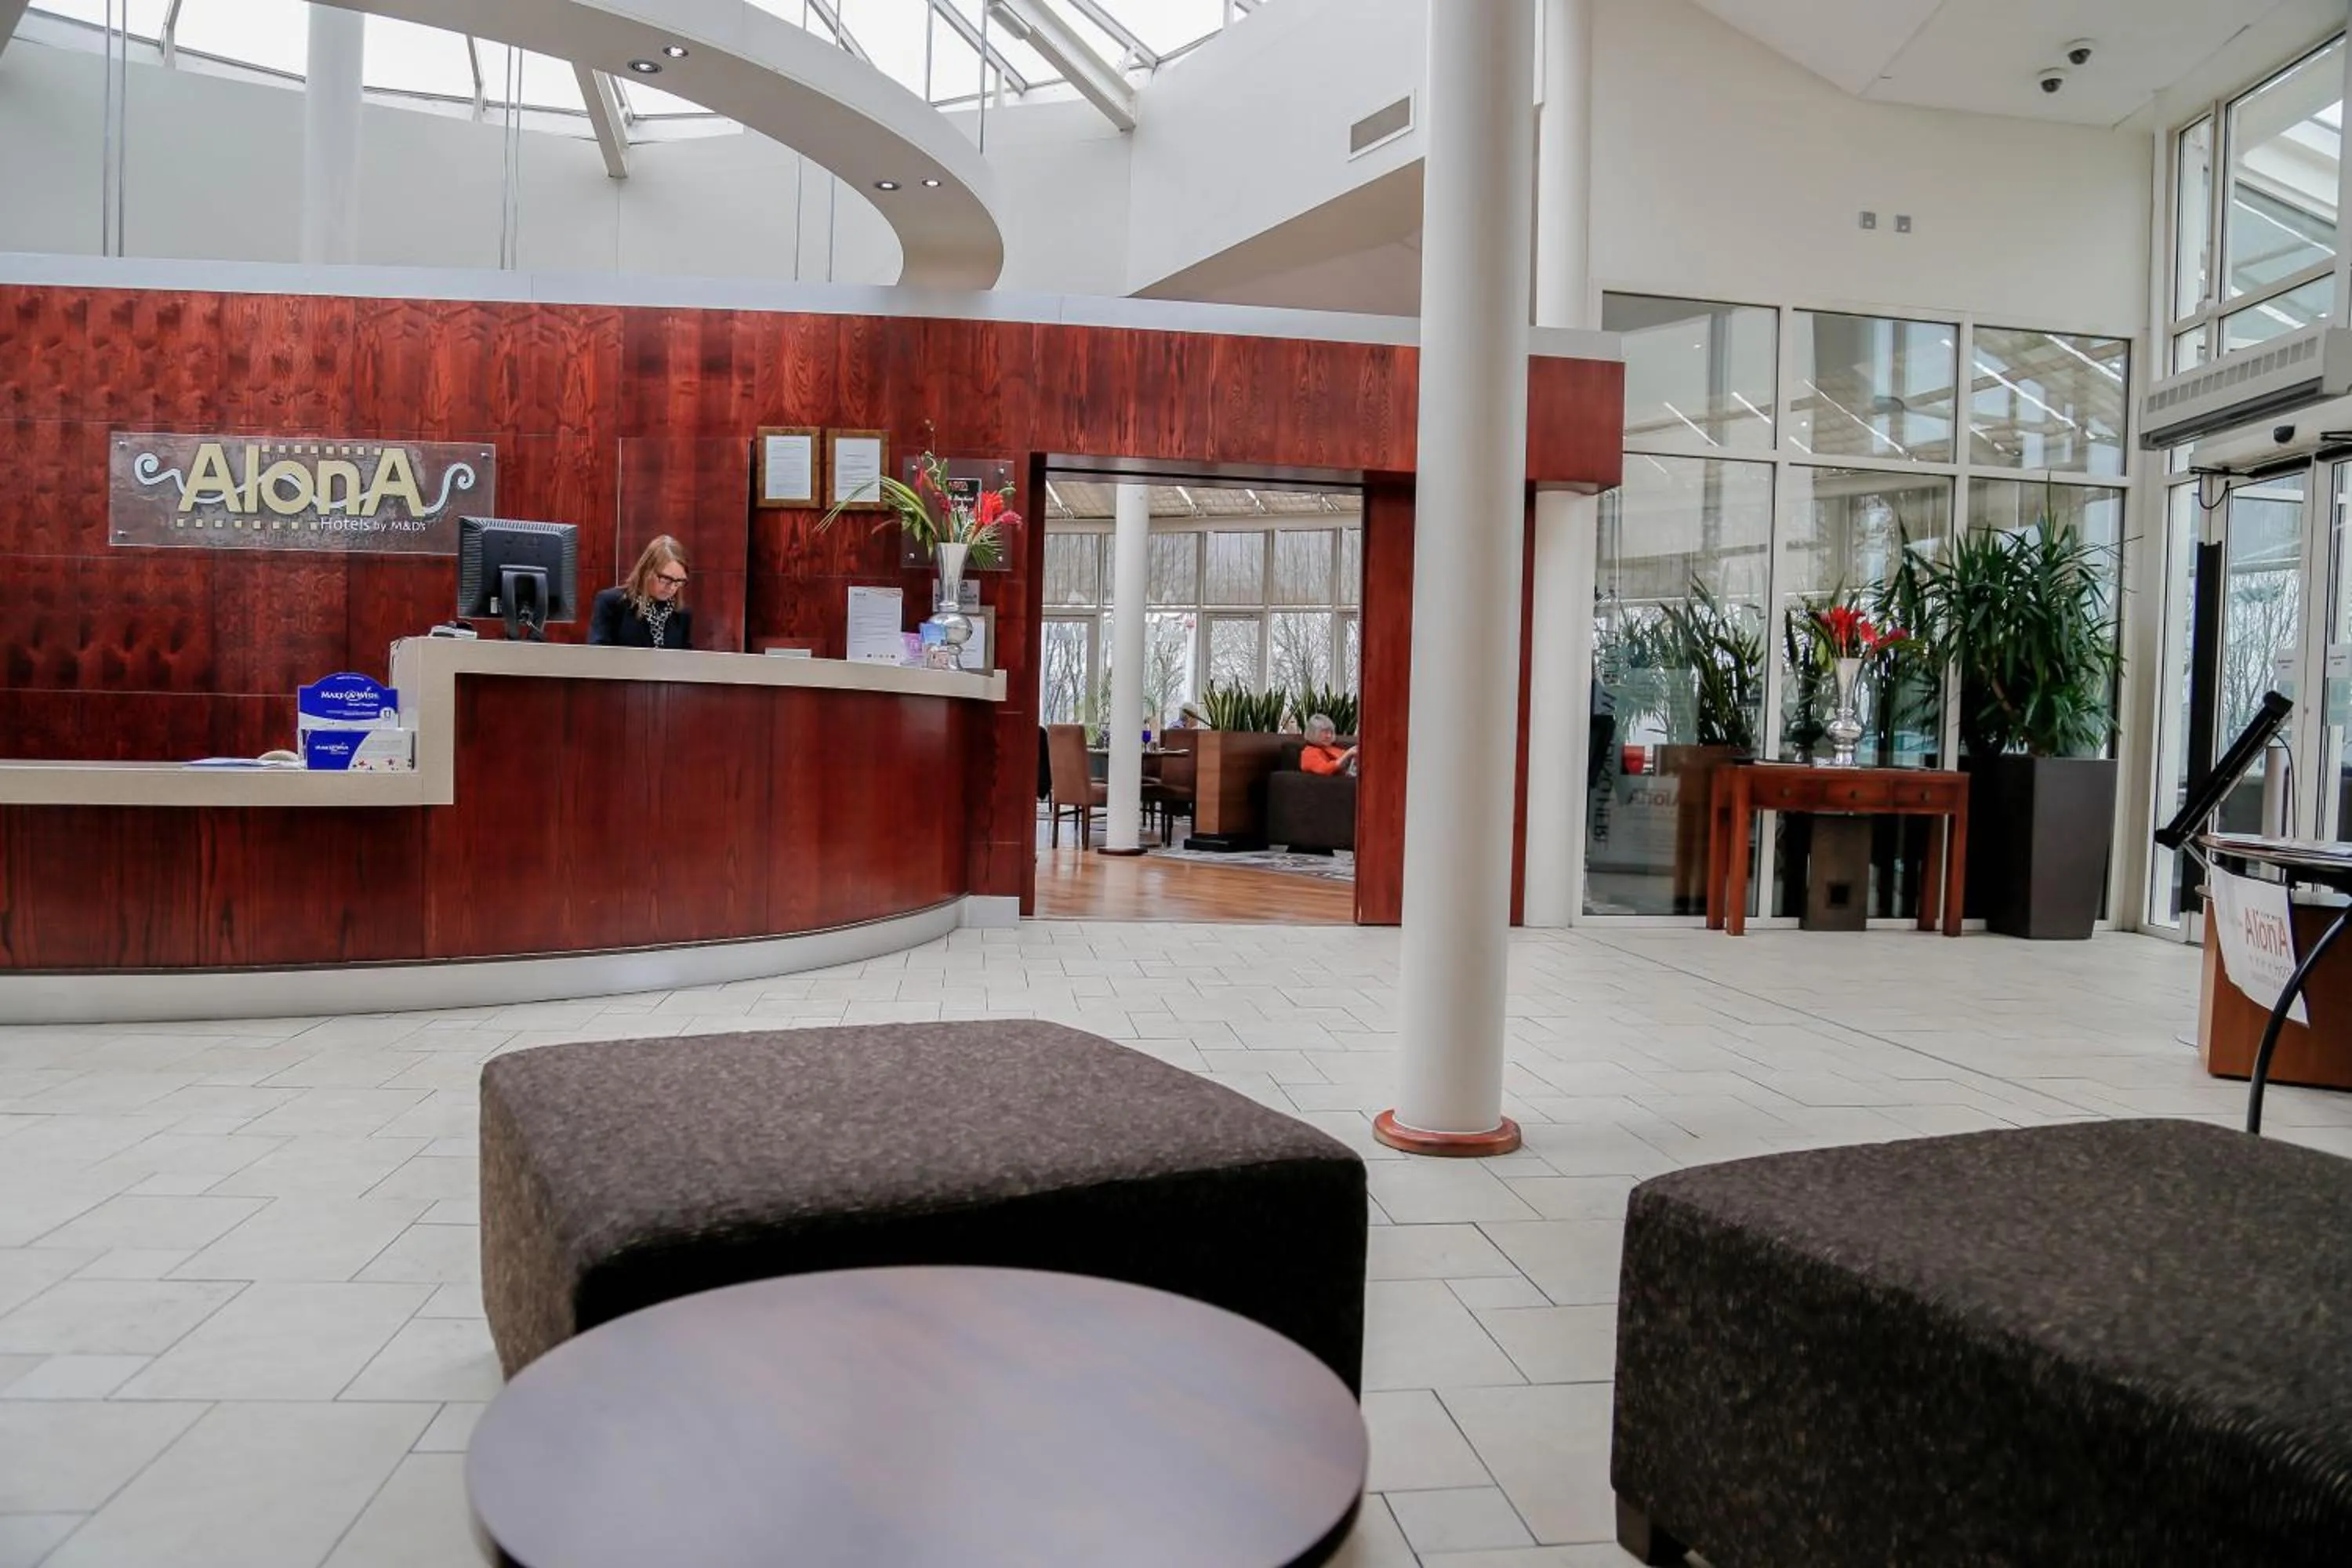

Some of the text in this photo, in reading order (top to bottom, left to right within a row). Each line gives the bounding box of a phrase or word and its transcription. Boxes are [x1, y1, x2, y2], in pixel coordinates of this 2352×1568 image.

[178, 443, 425, 517] AlonA
[321, 517, 371, 532] Hotels
[373, 521, 387, 532] by
